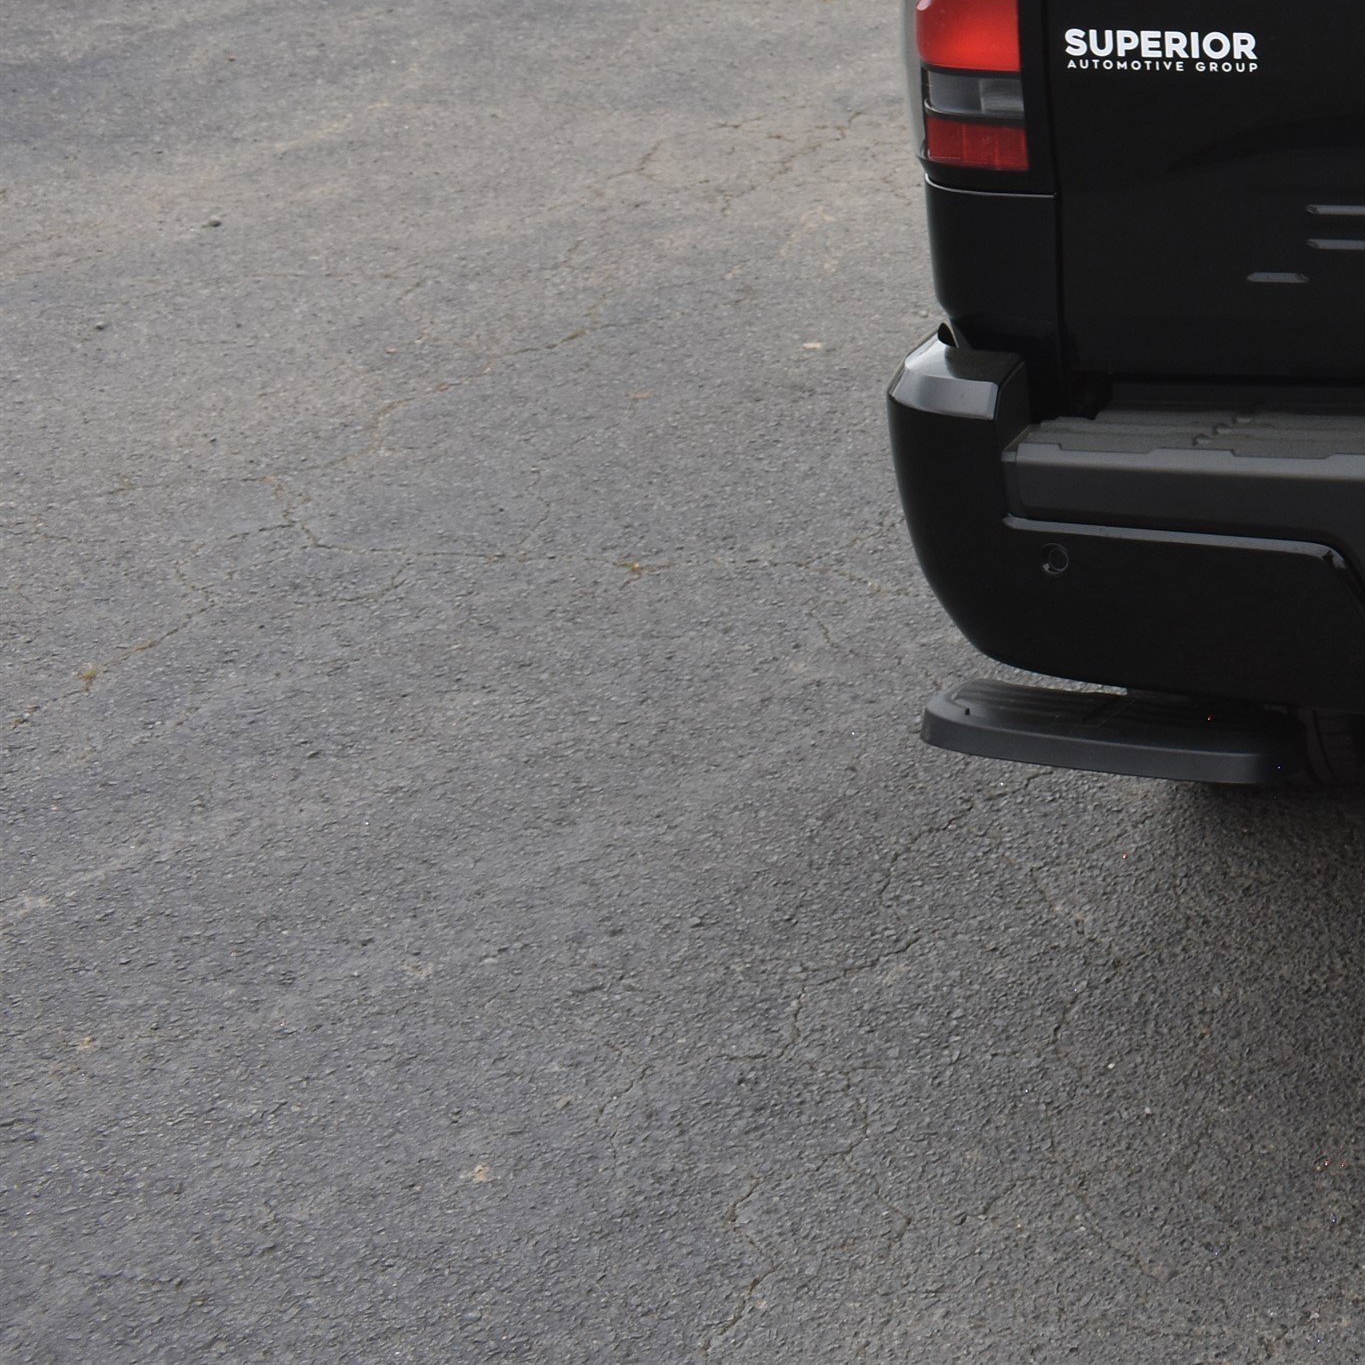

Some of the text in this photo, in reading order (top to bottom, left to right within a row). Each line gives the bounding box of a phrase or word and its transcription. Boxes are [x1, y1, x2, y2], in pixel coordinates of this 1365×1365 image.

[1064, 28, 1258, 59] SUPERIOR
[1067, 59, 1259, 73] AUTOMOTIVE GROUP
